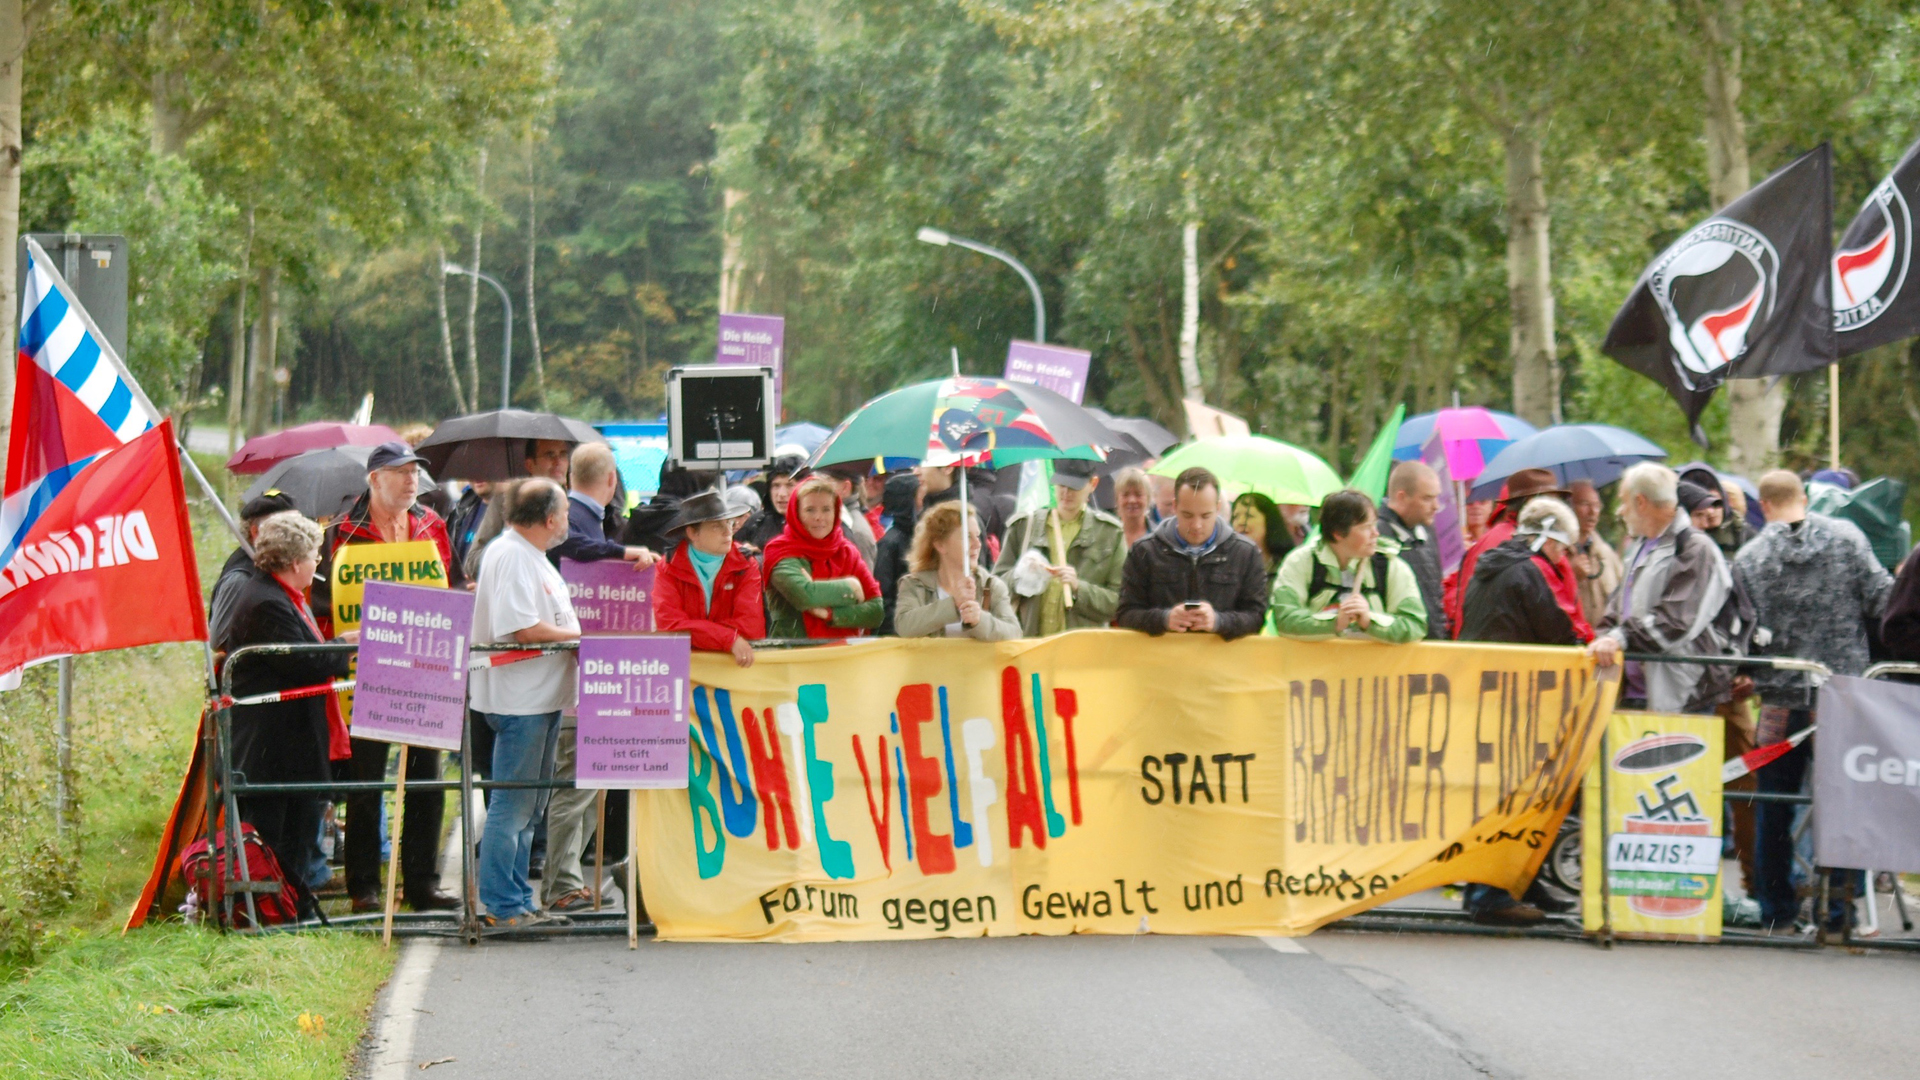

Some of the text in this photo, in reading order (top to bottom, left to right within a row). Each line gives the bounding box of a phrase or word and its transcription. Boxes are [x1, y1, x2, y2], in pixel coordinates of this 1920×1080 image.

[723, 330, 773, 345] Die Heide
[1012, 359, 1073, 379] Die Heide
[338, 562, 404, 585] GEGEN
[568, 583, 647, 602] Die Heide
[367, 605, 452, 630] Die Heide
[575, 605, 601, 620] lüht
[366, 627, 404, 645] blüht
[377, 657, 449, 673] und nicht braun
[584, 660, 670, 675] Die Heide
[362, 682, 464, 706] Rechtsextremismus
[584, 681, 623, 695] blüht
[390, 701, 427, 714] ist Gift
[597, 706, 670, 717] und nicht braun
[368, 711, 444, 730] für unser Land
[583, 736, 687, 746] Rechtsextremismus
[613, 749, 650, 759] ist Gift
[1289, 673, 1453, 846] BRAUNER
[592, 762, 669, 772] für unser Land
[1141, 753, 1255, 805] STATT
[1616, 843, 1694, 865] NAZIS?
[759, 884, 859, 924] Forum
[881, 893, 998, 932] gegen
[1022, 880, 1159, 921] Gewalt
[1183, 874, 1243, 911] und
